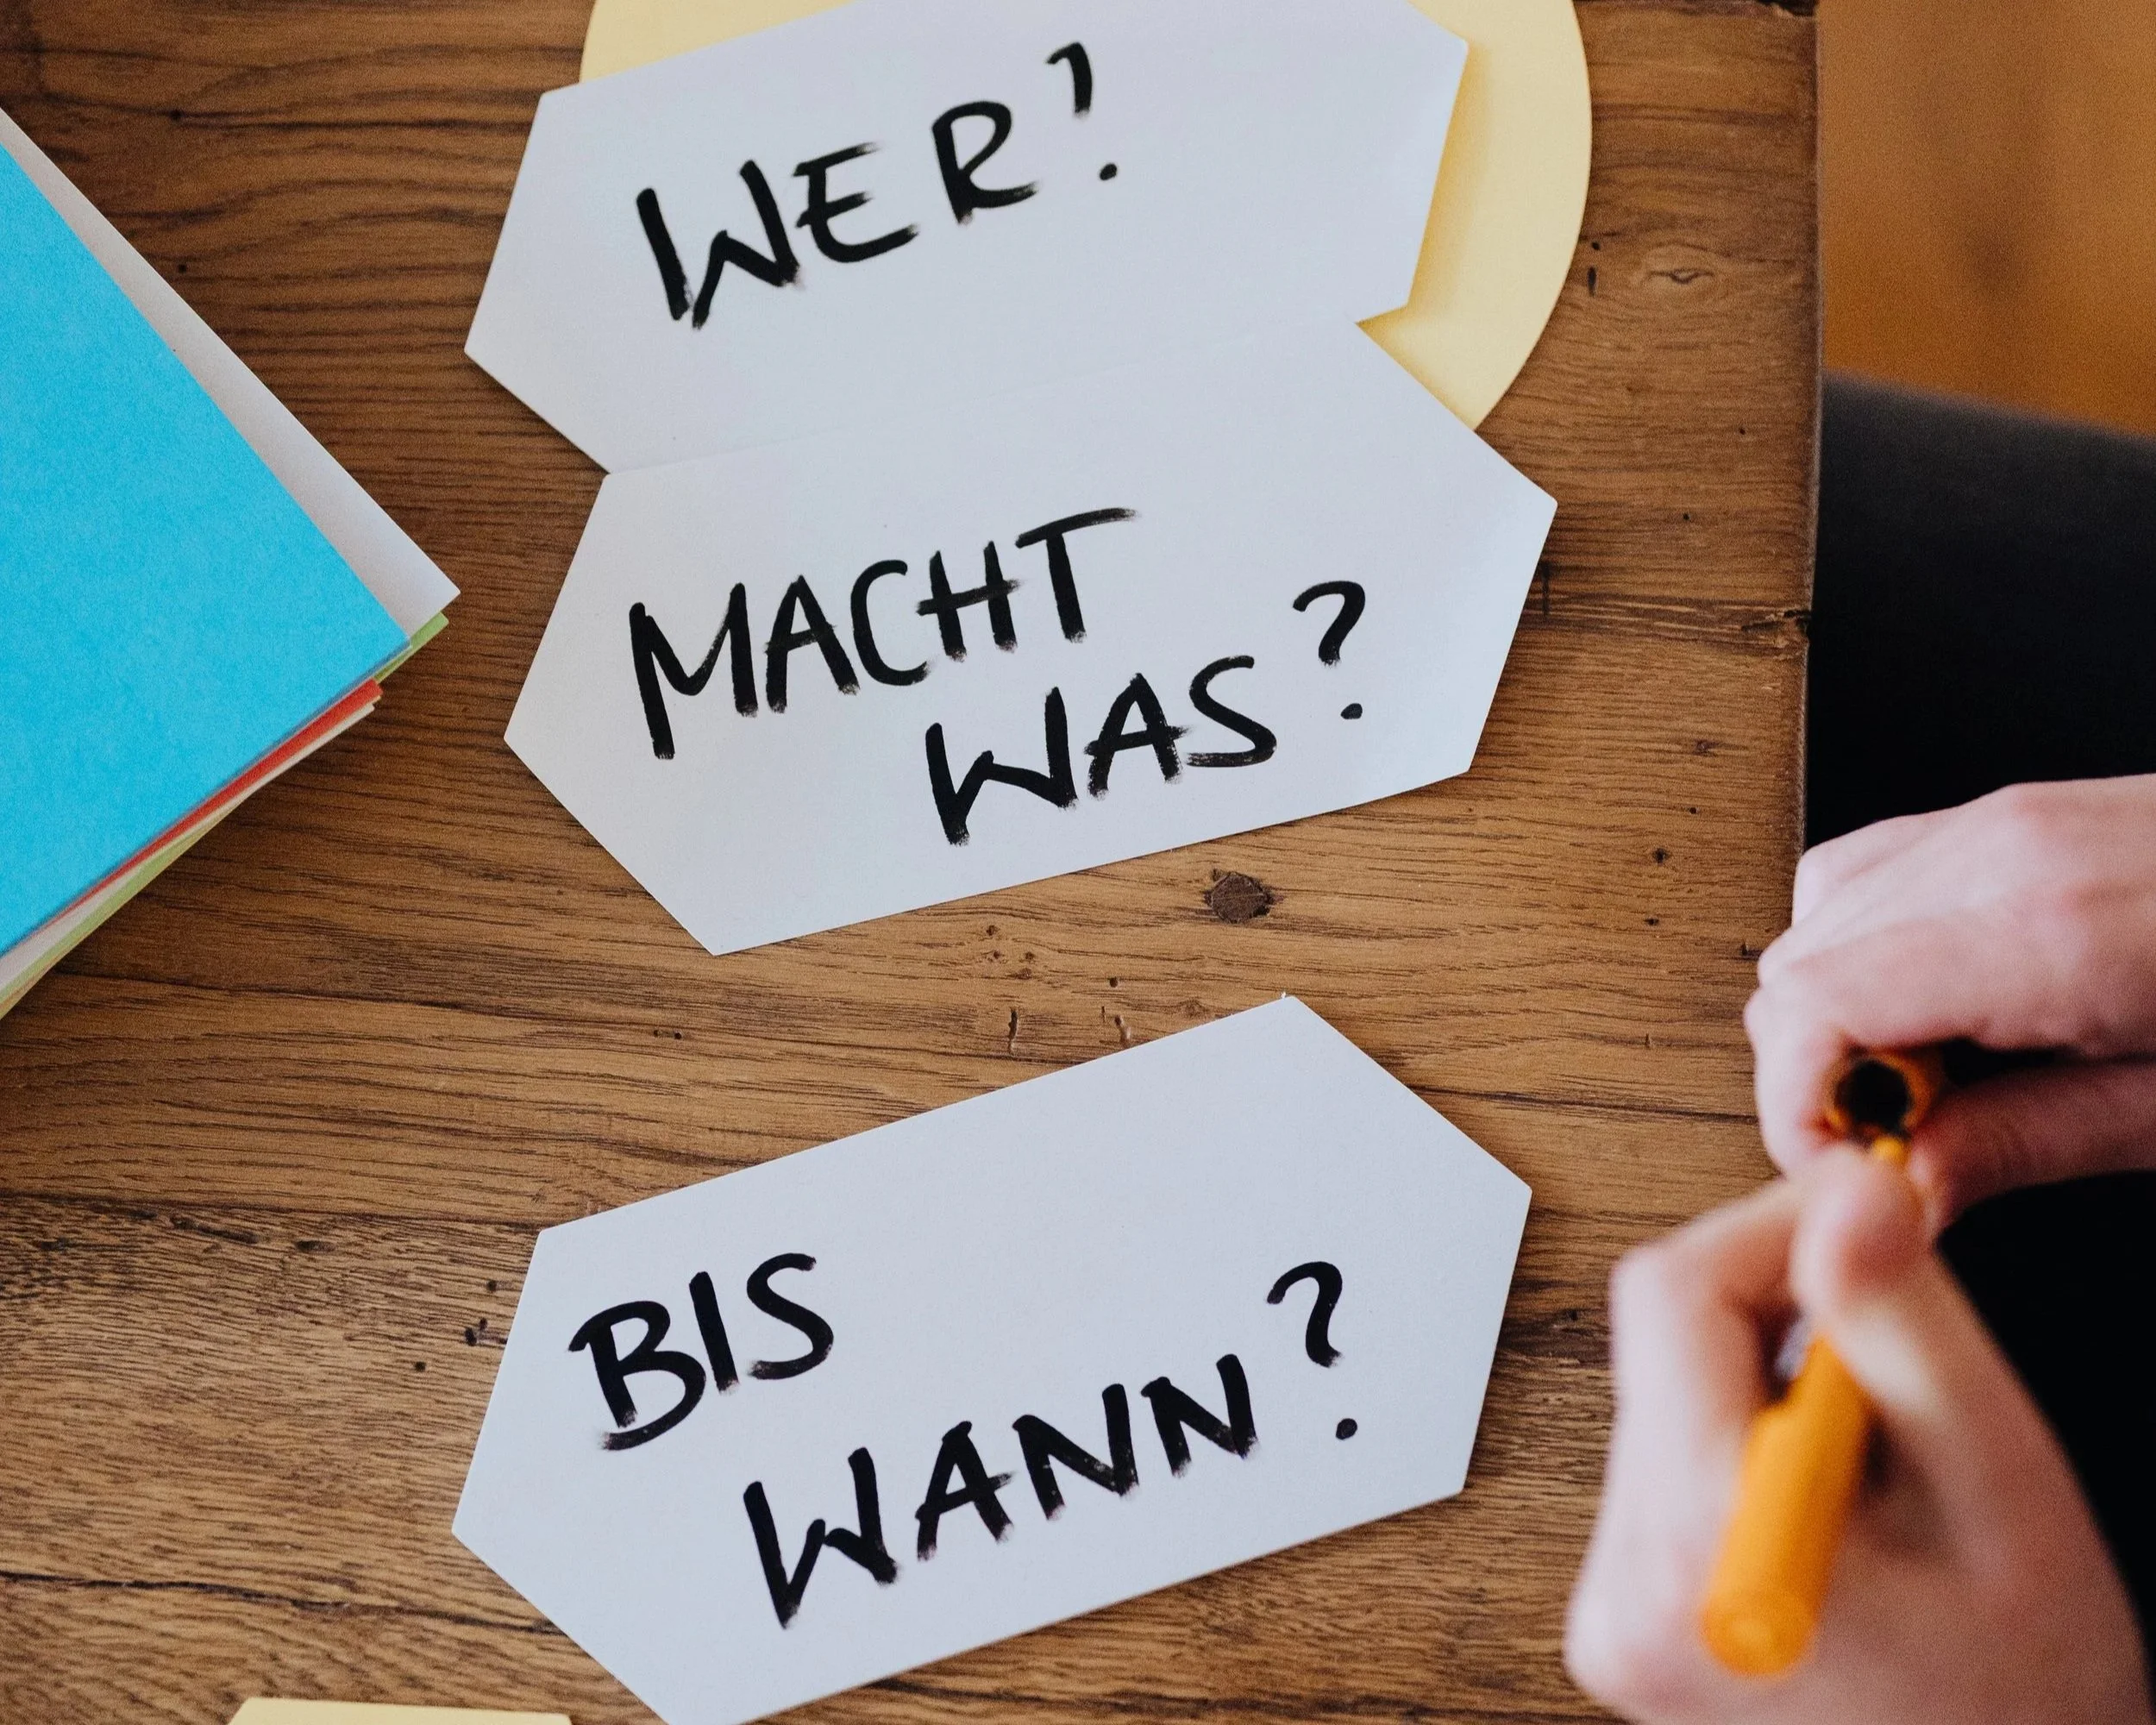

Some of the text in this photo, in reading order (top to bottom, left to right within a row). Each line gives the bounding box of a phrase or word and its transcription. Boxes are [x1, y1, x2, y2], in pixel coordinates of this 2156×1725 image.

[634, 41, 1121, 329] WER?
[628, 505, 1141, 761] MACHT
[924, 579, 1367, 847] WAS?
[568, 1251, 835, 1451] BIS
[741, 1259, 1360, 1630] WANN?
